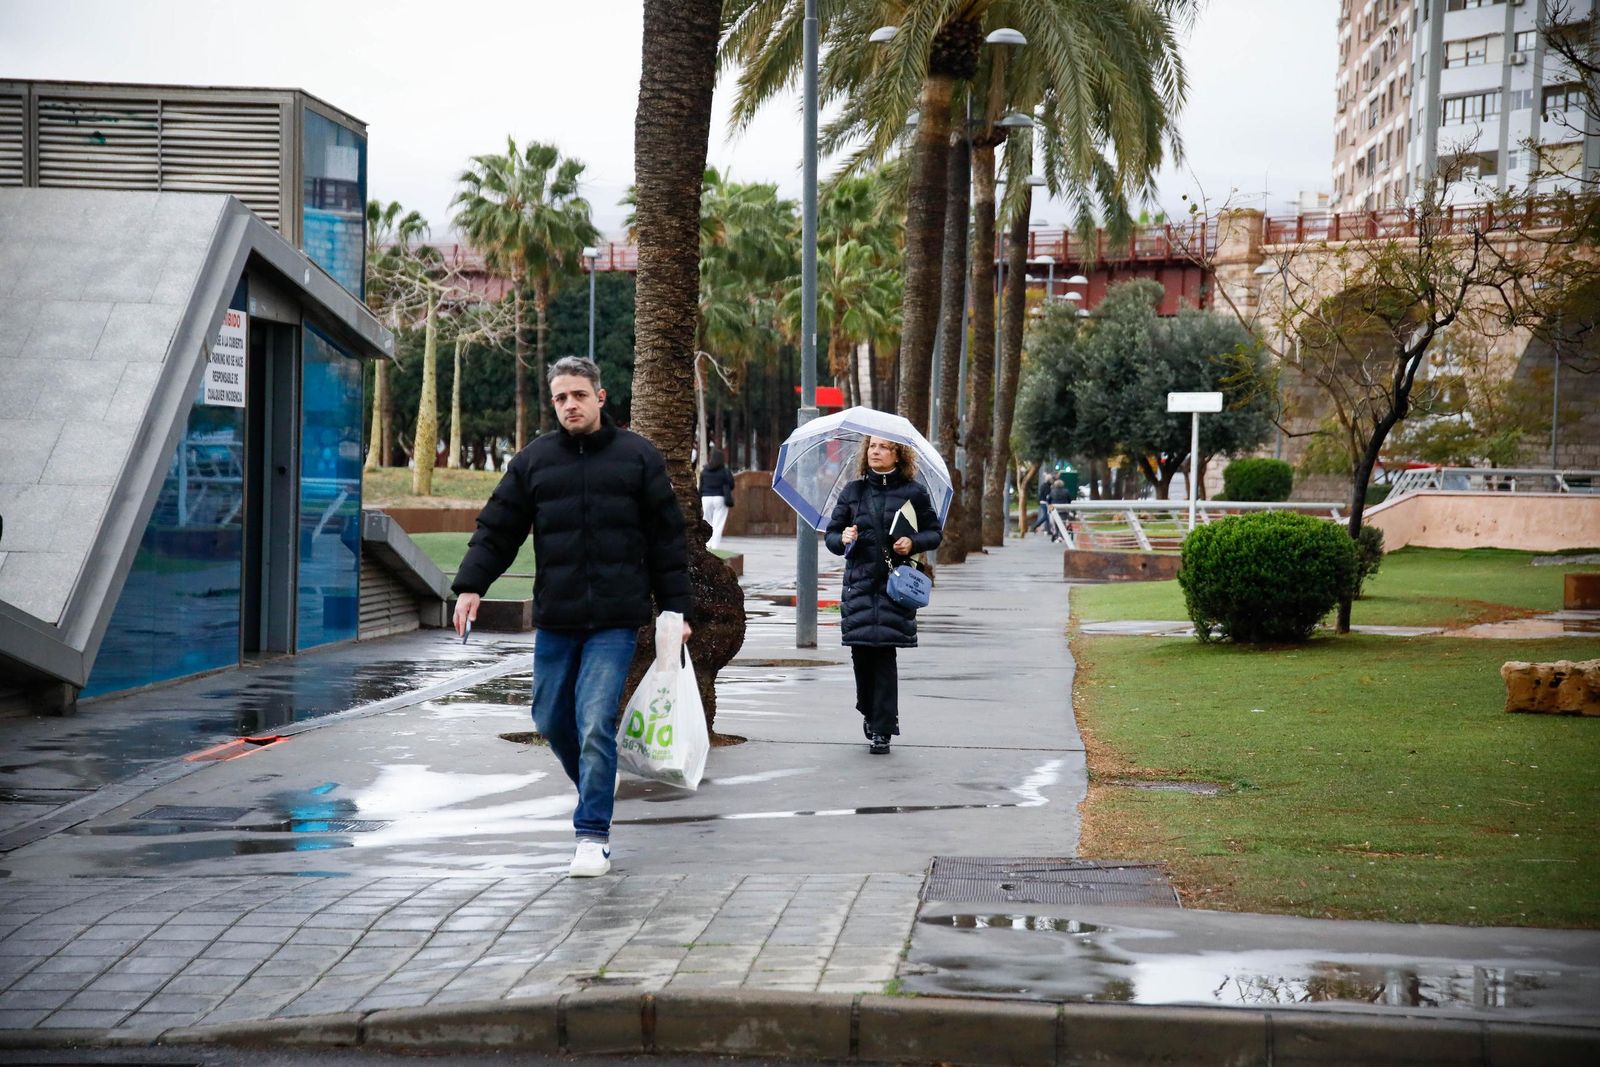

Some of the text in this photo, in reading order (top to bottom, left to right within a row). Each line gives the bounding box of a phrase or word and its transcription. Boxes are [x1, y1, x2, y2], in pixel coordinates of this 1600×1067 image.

[229, 337, 243, 349] CUBIERTA
[212, 352, 225, 365] PARKING
[226, 353, 231, 366] NO
[231, 354, 235, 366] SE
[235, 356, 243, 367] HACE
[212, 370, 239, 385] RESPONSABLE DE
[207, 388, 242, 402] CUALQUIER INCIDENCIA
